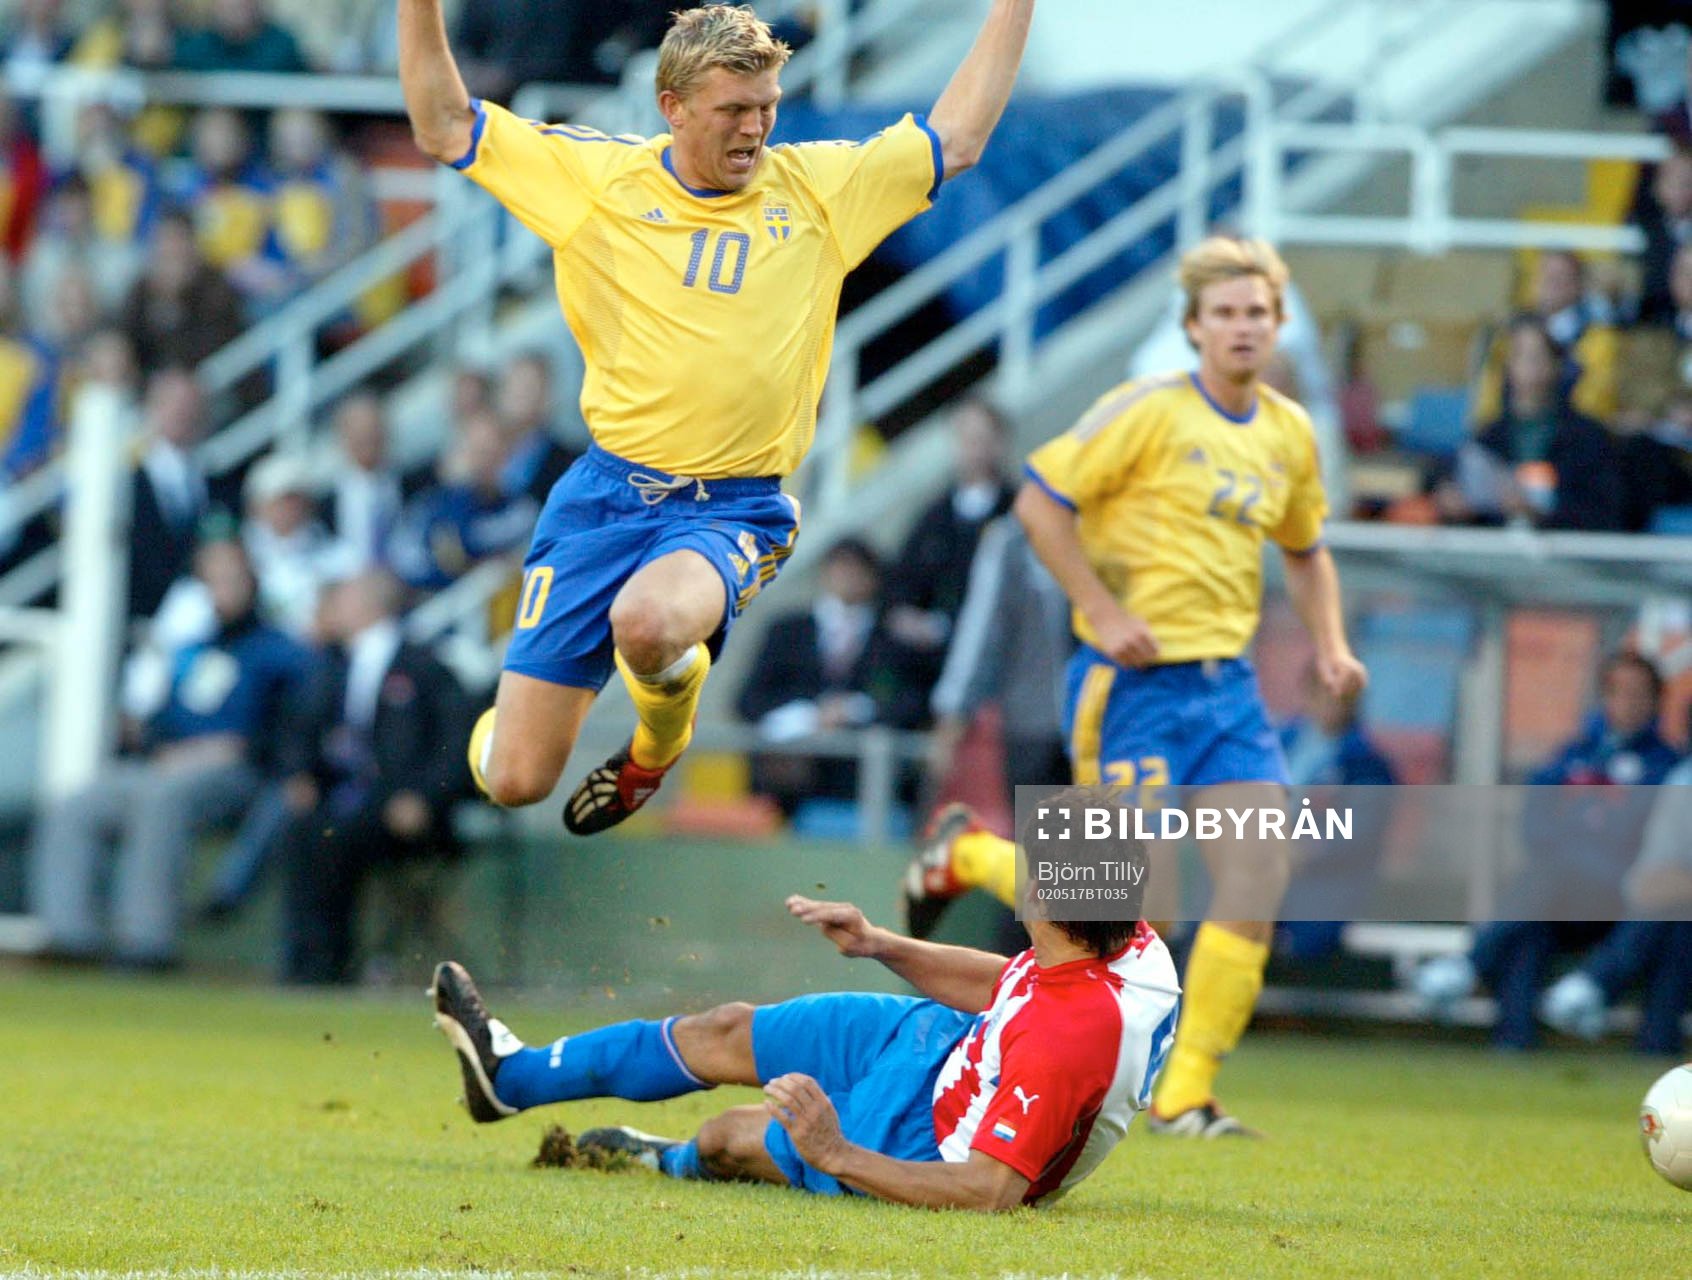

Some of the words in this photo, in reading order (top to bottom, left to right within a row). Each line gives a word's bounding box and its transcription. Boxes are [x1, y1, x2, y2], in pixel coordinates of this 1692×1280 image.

[682, 227, 751, 295] 10
[1207, 467, 1264, 526] 22
[517, 565, 555, 630] 0
